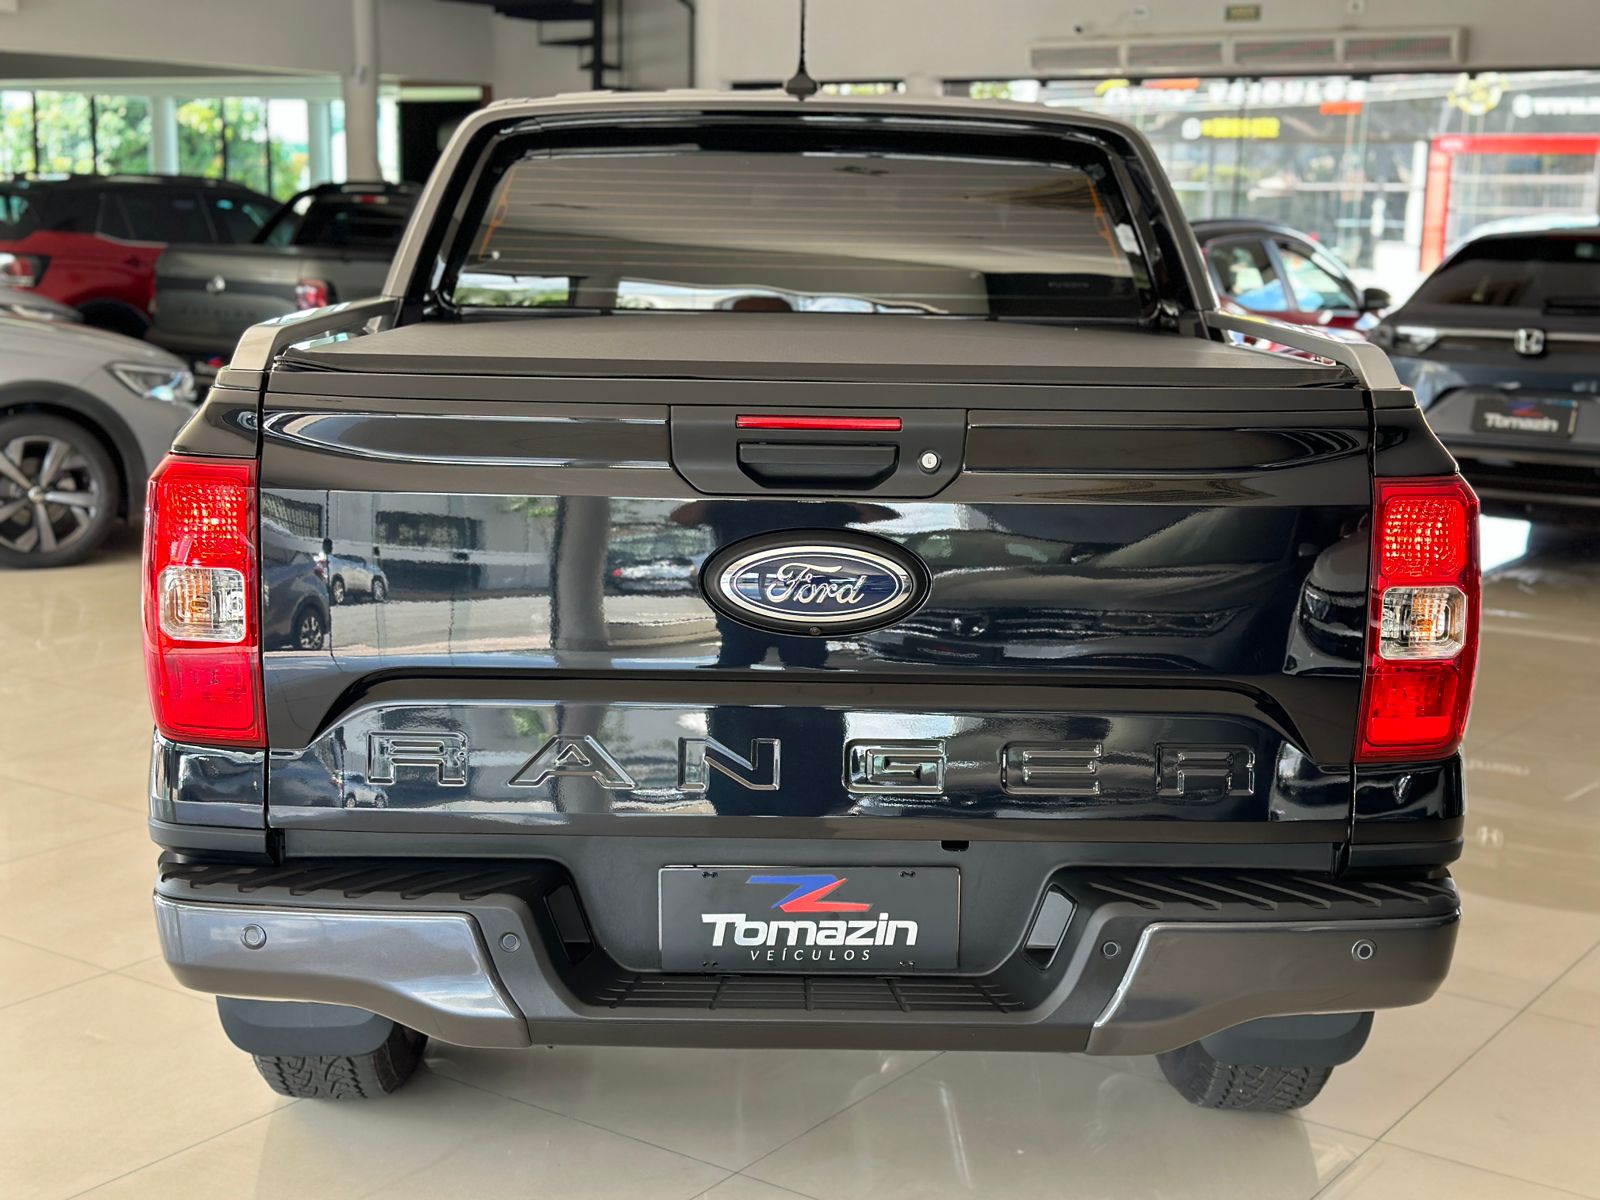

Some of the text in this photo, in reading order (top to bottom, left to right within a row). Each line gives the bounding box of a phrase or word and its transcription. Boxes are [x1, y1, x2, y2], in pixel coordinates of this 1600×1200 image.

[765, 562, 864, 604] Ford
[366, 730, 1255, 797] RANGER
[701, 912, 918, 947] Tomazin
[750, 947, 871, 961] VEÍCULOS
